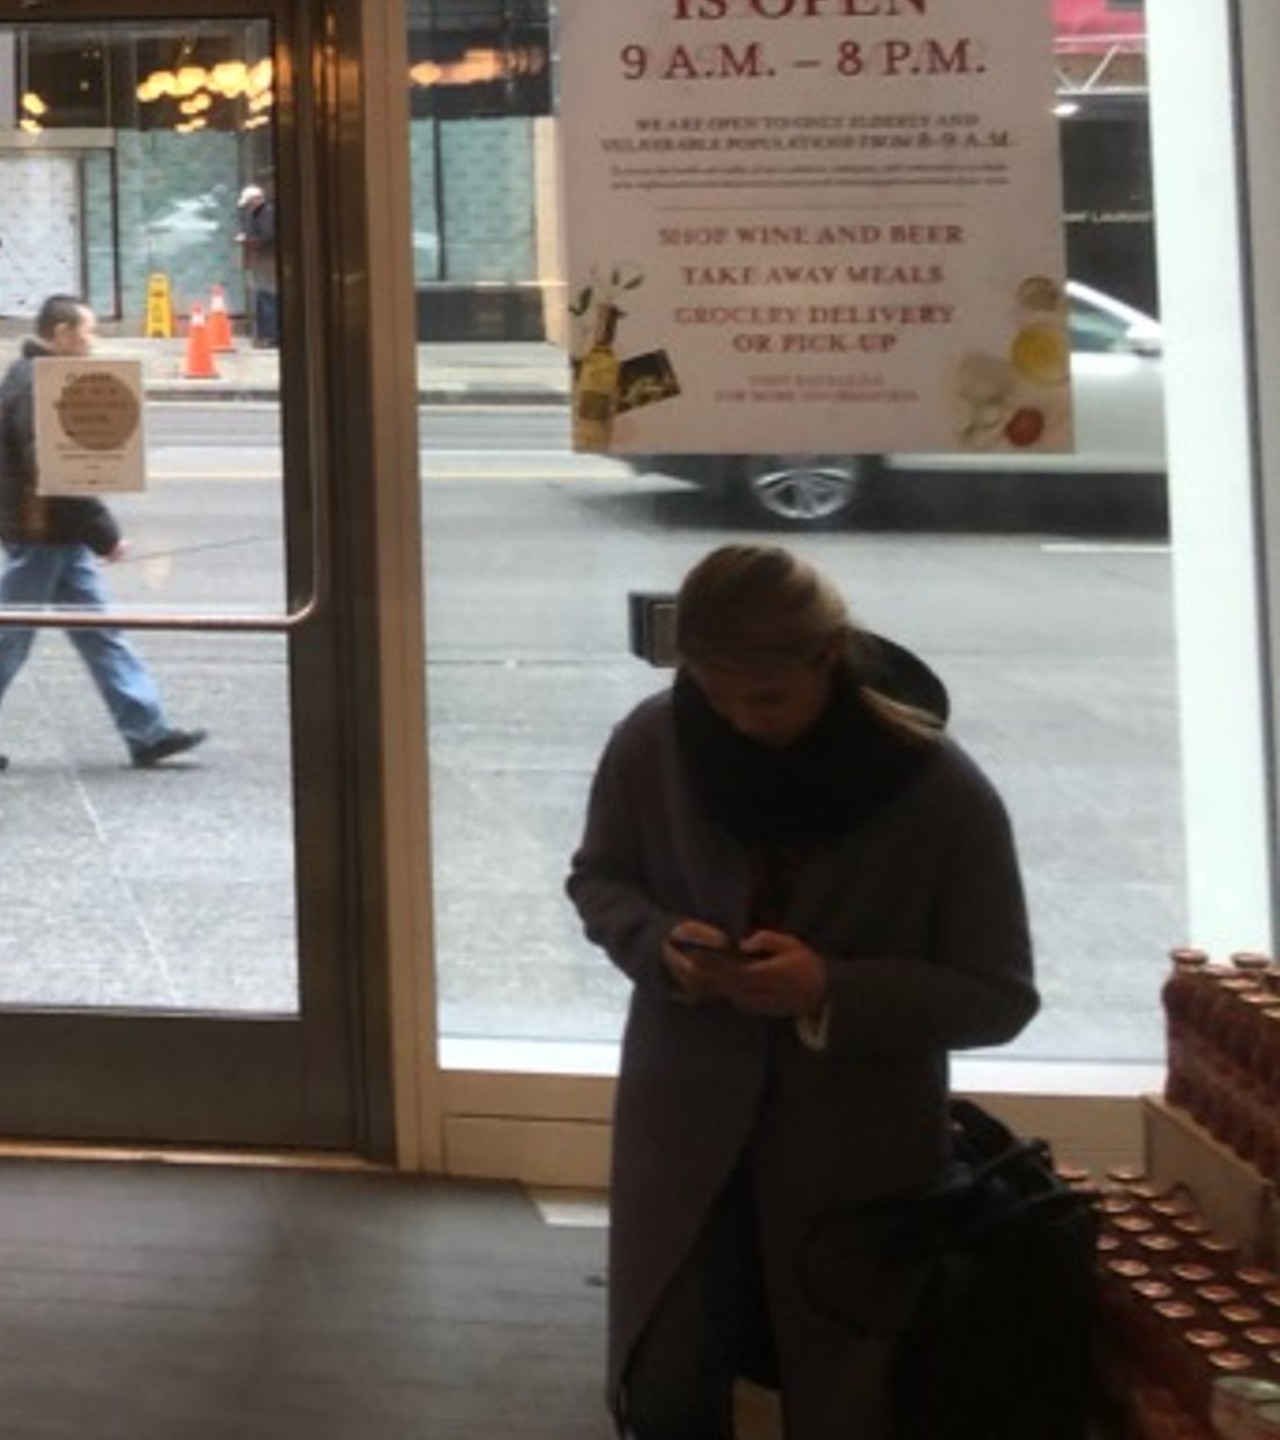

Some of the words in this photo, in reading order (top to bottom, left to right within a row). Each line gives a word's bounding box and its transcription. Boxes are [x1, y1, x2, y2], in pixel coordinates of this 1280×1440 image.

[620, 44, 648, 80] 9
[662, 42, 776, 79] A.M.
[836, 40, 863, 76] 8
[883, 38, 986, 75] P.M.
[658, 228, 728, 245] SHOP
[736, 227, 809, 245] WINE
[815, 226, 881, 245] AND
[890, 225, 964, 244] BEER
[682, 266, 753, 285] TAKE
[766, 266, 837, 285] AWAY
[847, 265, 943, 284] MEALS
[675, 307, 796, 324] GROCERY
[809, 305, 955, 324] DELIVERY
